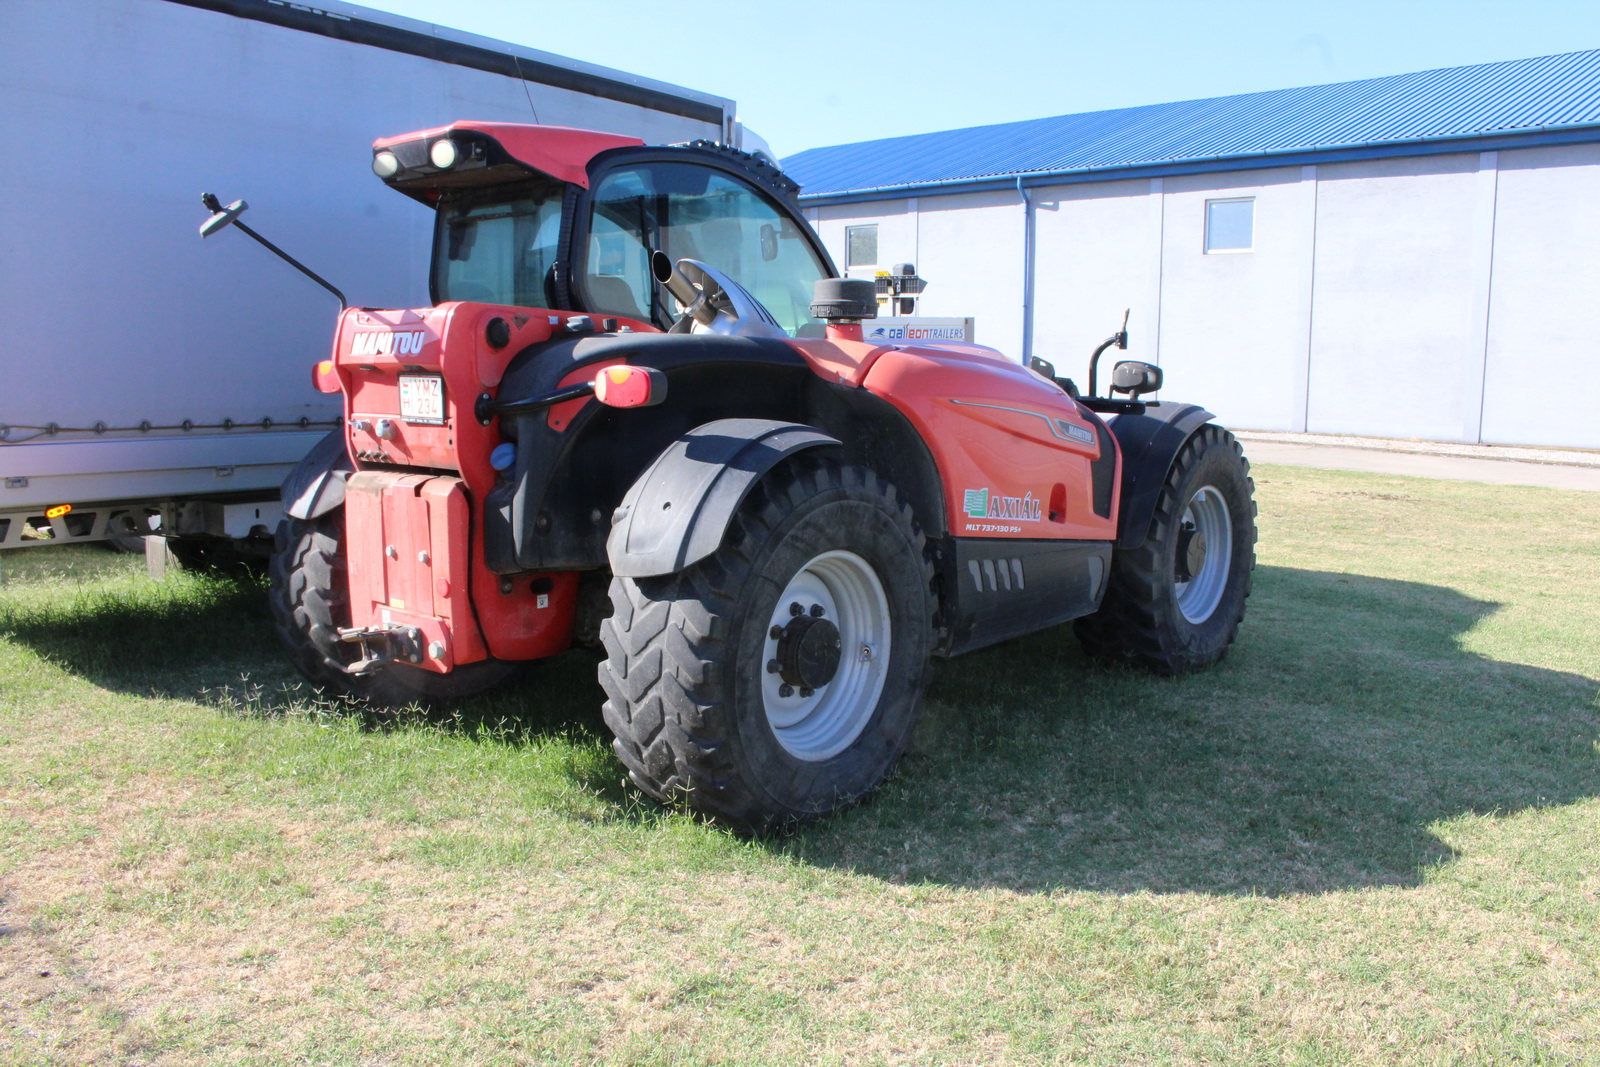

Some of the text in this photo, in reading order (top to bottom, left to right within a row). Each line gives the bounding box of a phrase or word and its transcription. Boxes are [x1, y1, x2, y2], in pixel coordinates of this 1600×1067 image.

[350, 331, 425, 355] MANITOU
[415, 379, 439, 397] YMZ
[417, 398, 437, 415] 234
[988, 491, 1041, 521] AXIÁL
[965, 523, 981, 531] MLT
